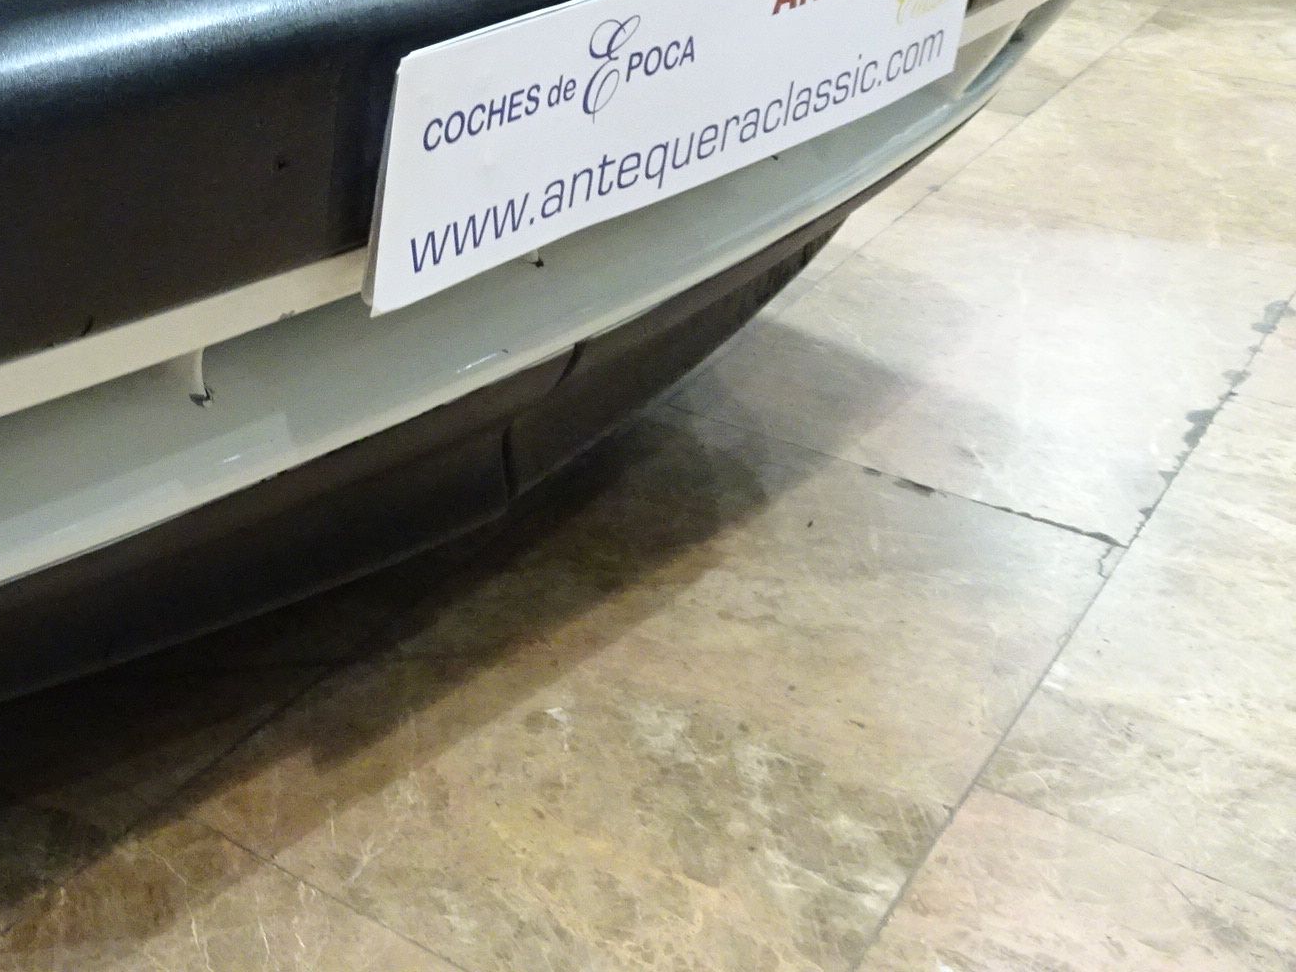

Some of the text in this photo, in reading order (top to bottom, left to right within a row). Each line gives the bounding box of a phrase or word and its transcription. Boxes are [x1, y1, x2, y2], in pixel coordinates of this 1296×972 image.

[410, 29, 944, 274] www.antequeraclassic.com
[423, 84, 540, 151] COCHES
[547, 75, 577, 108] de
